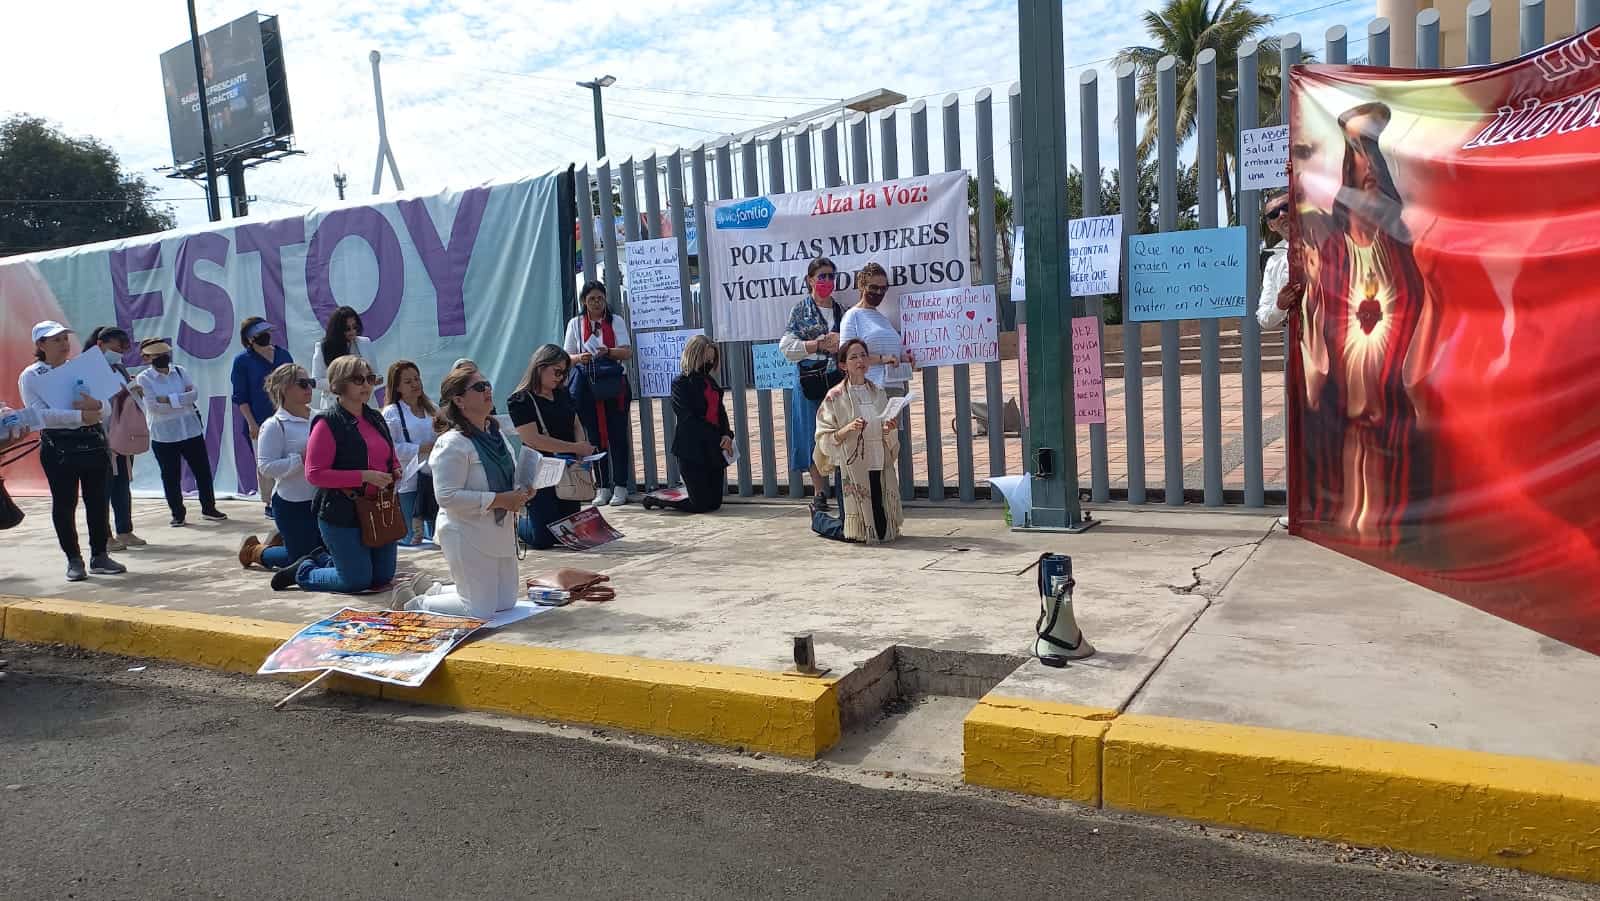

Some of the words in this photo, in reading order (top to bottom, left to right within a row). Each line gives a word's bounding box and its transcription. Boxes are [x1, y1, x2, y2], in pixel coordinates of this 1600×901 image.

[1245, 142, 1274, 154] salud
[811, 193, 853, 216] Alza
[858, 188, 876, 210] la
[882, 184, 929, 207] Voz:
[730, 244, 775, 267] POR
[779, 238, 823, 262] LAS
[829, 221, 950, 257] MUJERES
[1135, 240, 1161, 256] Que
[1171, 245, 1185, 255] no
[1193, 245, 1213, 254] nos
[1134, 261, 1168, 271] maten
[1177, 261, 1190, 270] en
[1197, 258, 1207, 268] la
[1214, 255, 1239, 267] calle
[109, 188, 492, 368] ESTOY
[886, 258, 965, 287] BUSO
[1134, 280, 1155, 296] Que
[1166, 285, 1181, 294] no
[1189, 284, 1210, 294] nos
[1134, 298, 1166, 313] maten
[1175, 301, 1189, 311] en
[1194, 297, 1204, 308] el
